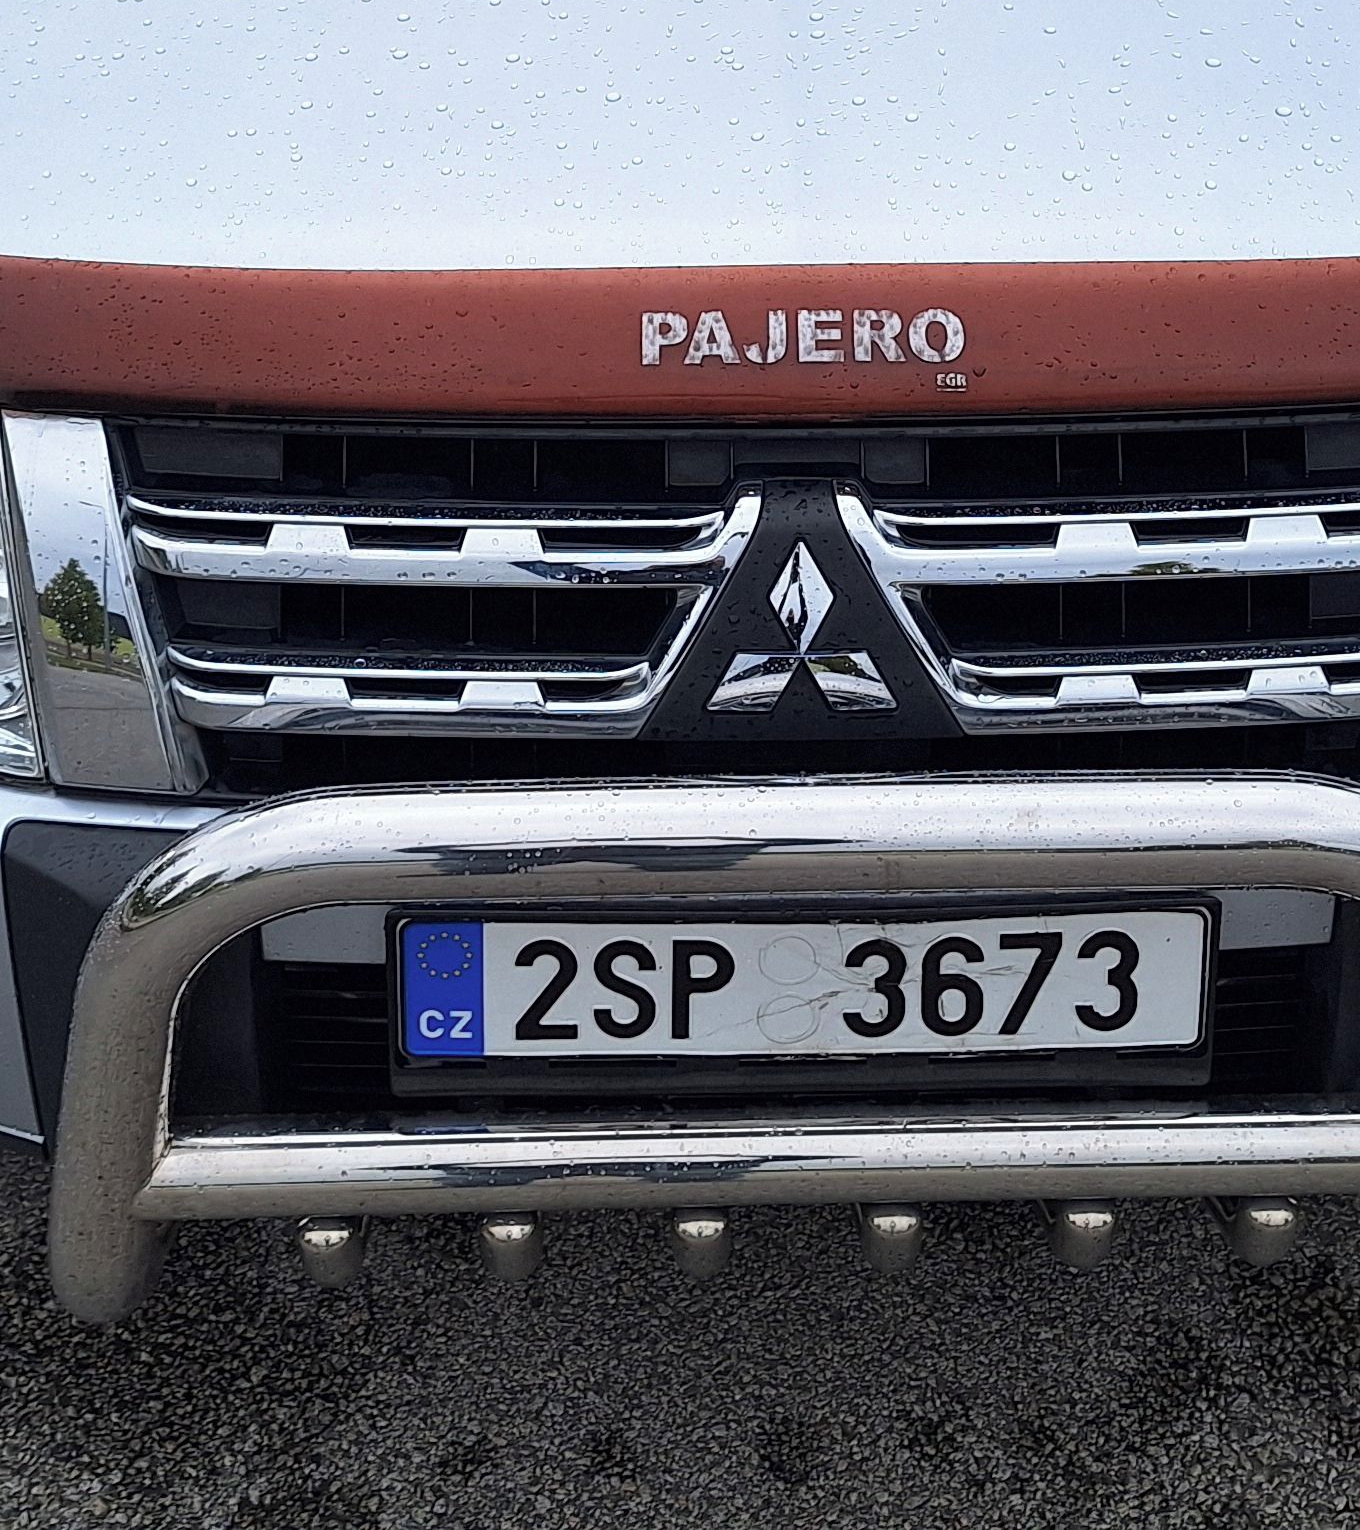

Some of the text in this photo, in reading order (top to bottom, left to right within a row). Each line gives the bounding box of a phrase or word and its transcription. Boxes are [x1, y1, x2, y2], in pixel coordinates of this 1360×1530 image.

[641, 308, 967, 365] PAJERO
[936, 372, 967, 388] EGR
[514, 929, 1140, 1041] 2SP 3673
[418, 1009, 474, 1039] CZ
